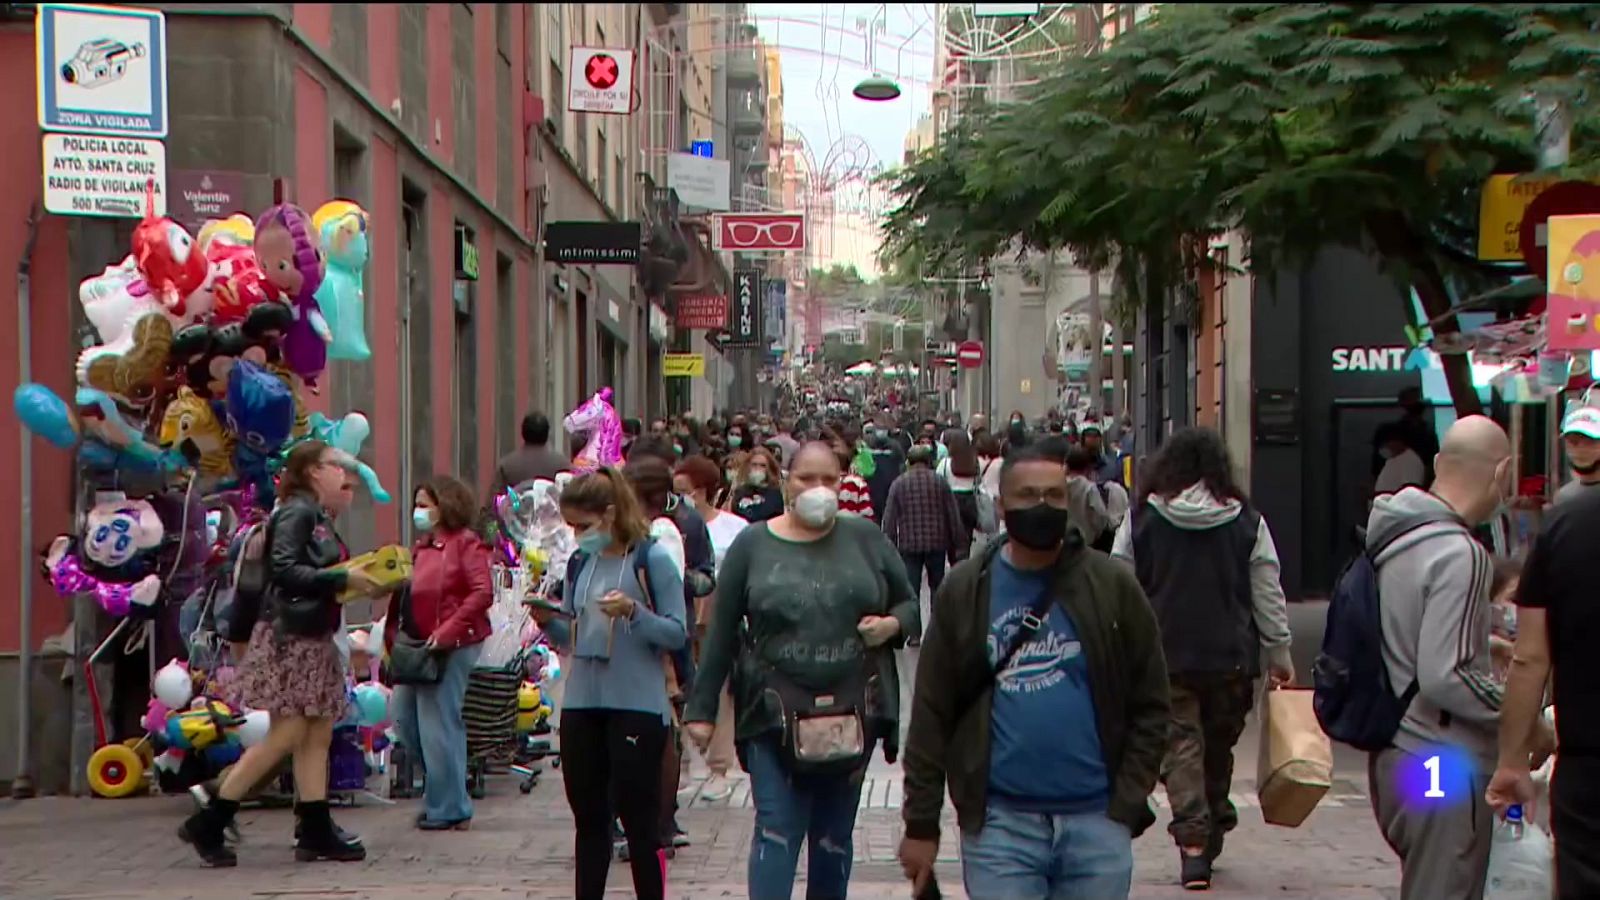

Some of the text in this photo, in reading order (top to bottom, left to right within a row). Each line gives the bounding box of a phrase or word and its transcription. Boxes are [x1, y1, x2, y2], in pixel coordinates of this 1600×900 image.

[603, 91, 617, 99] POR
[58, 112, 152, 130] ZONA VIGILADA
[63, 137, 148, 155] POLICIA LOCAL
[53, 156, 156, 175] AYTO. SANTA CRUZ
[48, 176, 161, 194] RADIO DE VIGILANCA
[72, 197, 92, 210] 500
[559, 247, 637, 258] intimissimi
[740, 275, 751, 335] KASINO
